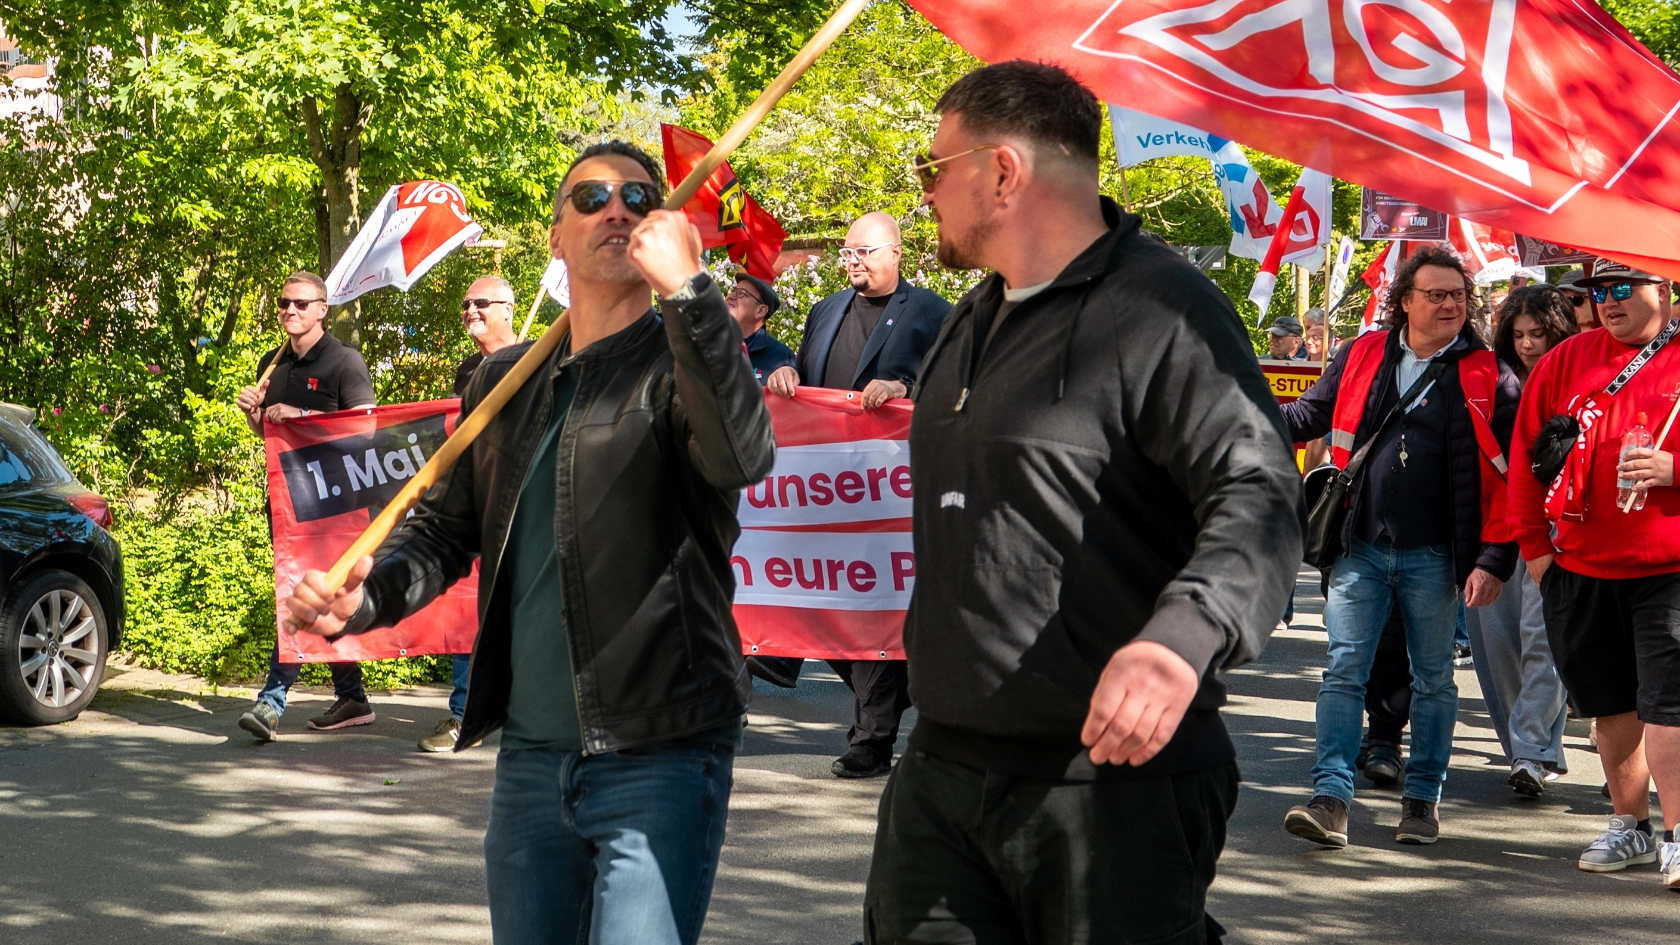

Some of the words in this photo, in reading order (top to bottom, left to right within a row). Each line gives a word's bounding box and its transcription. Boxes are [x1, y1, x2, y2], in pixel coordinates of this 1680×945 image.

[1622, 355, 1646, 378] KANI
[306, 460, 341, 500] 1.
[342, 432, 427, 492] Mai
[746, 464, 913, 509] unsere
[764, 556, 877, 593] eure
